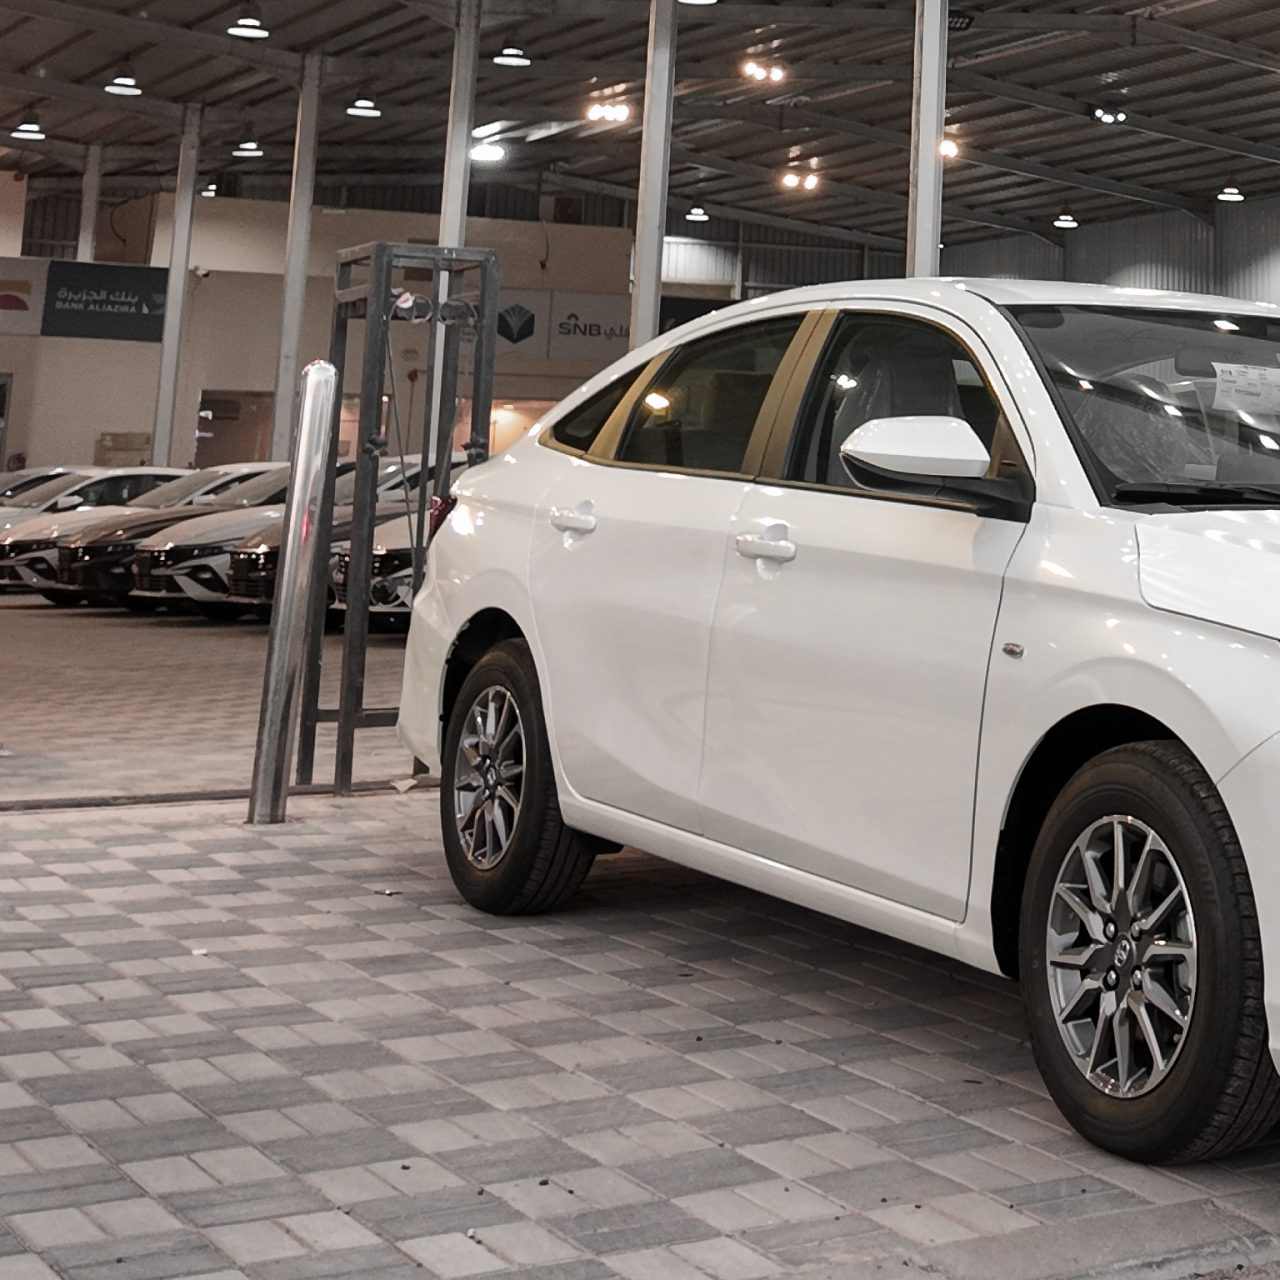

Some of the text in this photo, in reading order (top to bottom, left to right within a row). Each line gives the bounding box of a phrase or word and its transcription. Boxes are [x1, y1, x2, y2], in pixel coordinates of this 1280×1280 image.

[56, 287, 139, 304] بنك الجزيرة
[55, 301, 85, 311] BANK
[558, 321, 601, 337] SNB
